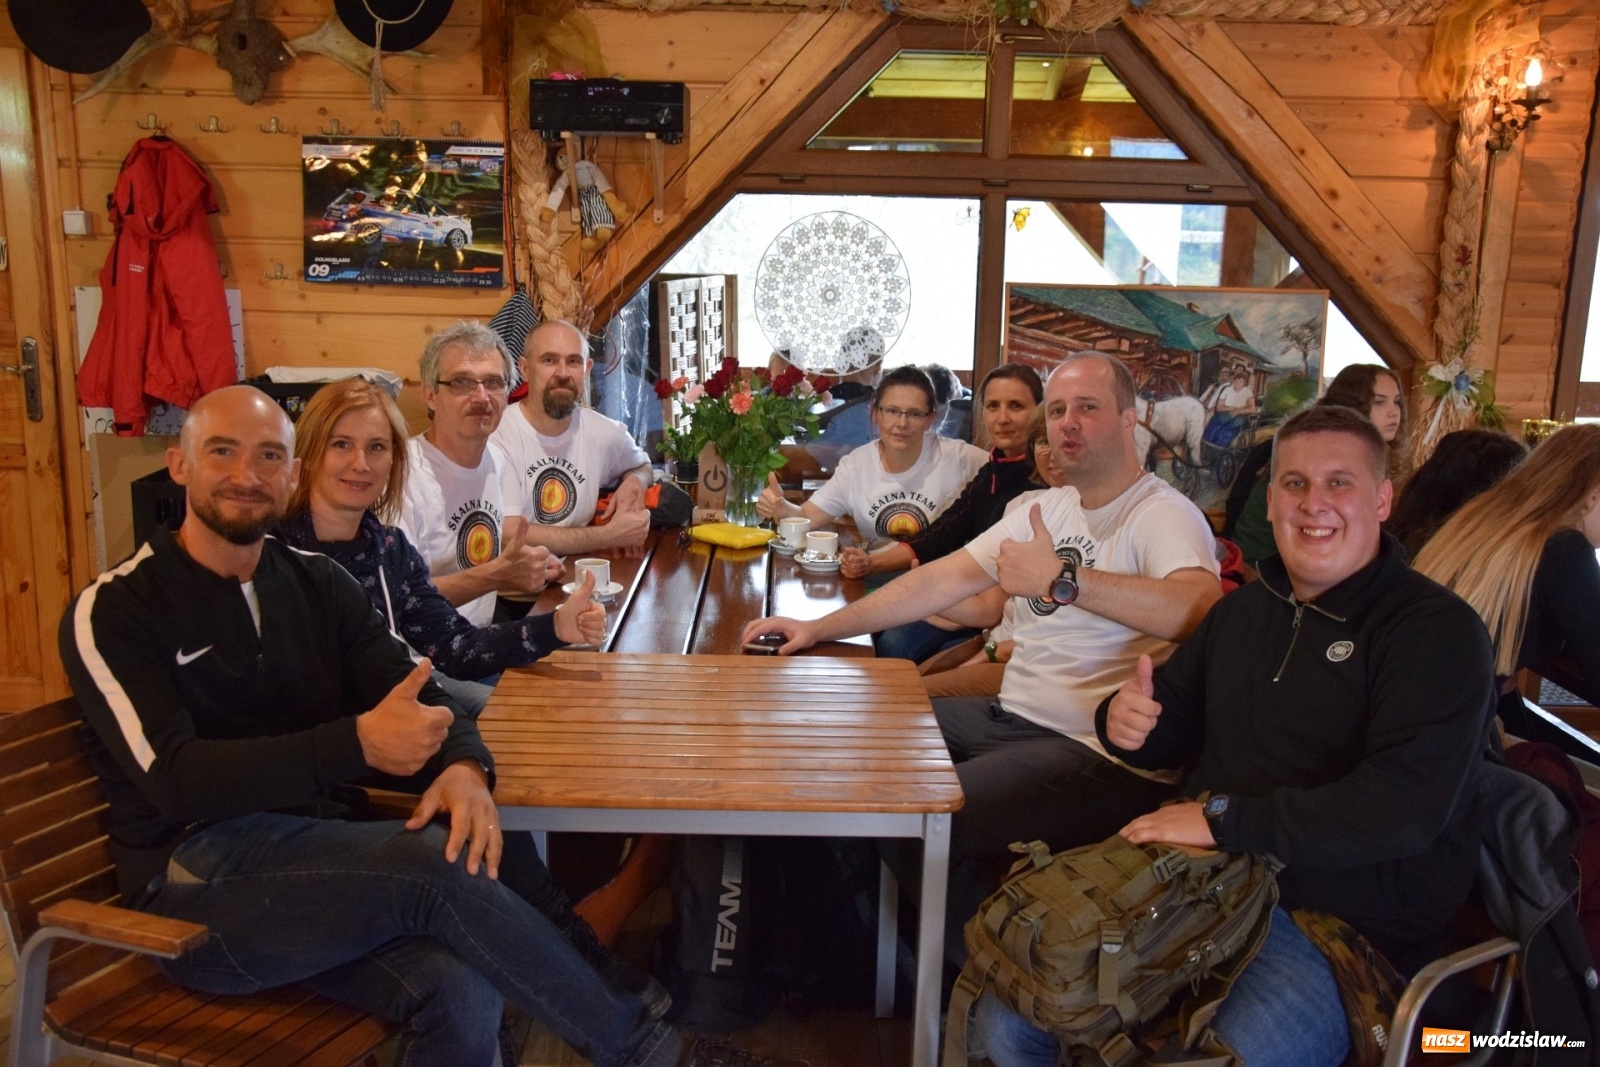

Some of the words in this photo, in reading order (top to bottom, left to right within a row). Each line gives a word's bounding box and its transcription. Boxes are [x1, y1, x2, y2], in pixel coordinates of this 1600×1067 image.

[308, 264, 330, 277] 09
[561, 459, 586, 484] TEAM
[448, 498, 481, 531] SKALNA
[868, 492, 906, 518] SKALNA
[910, 492, 936, 512] TEAM
[1082, 540, 1096, 568] TEM
[711, 876, 742, 973] TEAM
